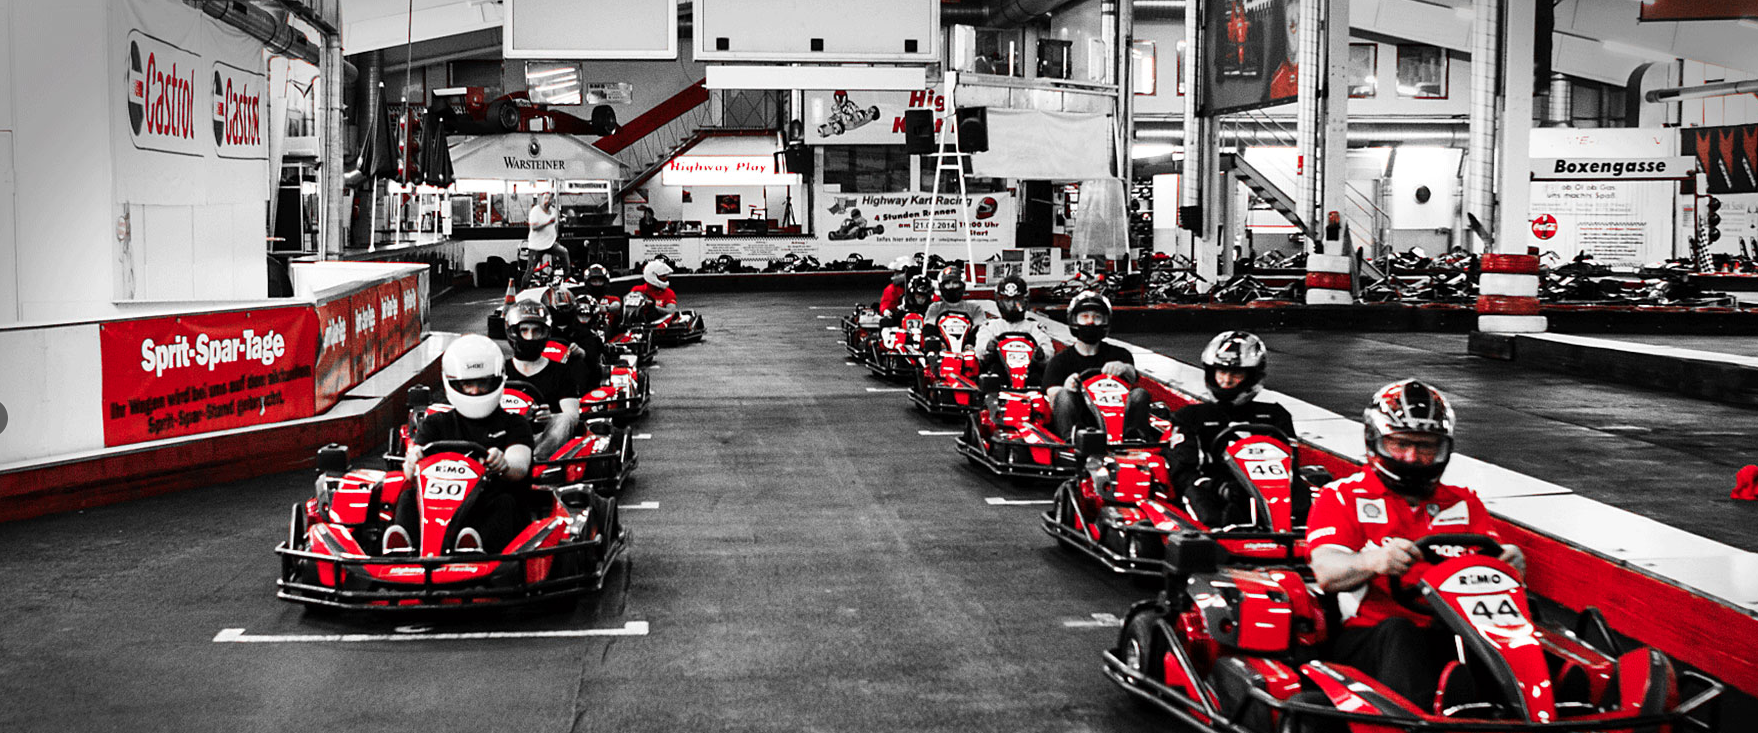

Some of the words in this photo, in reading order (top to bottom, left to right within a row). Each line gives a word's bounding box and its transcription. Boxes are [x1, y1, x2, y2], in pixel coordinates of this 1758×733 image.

[145, 52, 194, 140] Castrol
[225, 77, 260, 146] Castrol
[503, 156, 565, 170] WARSTEINER
[669, 160, 729, 173] Highway
[736, 162, 766, 173] Play
[1554, 159, 1667, 176] Boxengasse
[862, 195, 909, 207] Highway
[910, 195, 932, 205] Kart
[883, 211, 920, 221] Stunden
[922, 208, 957, 217] Rnnen
[141, 329, 285, 378] Sprit-Spar-Tage
[1252, 464, 1283, 475] 46
[428, 482, 462, 496] 50
[1472, 599, 1519, 619] 44
